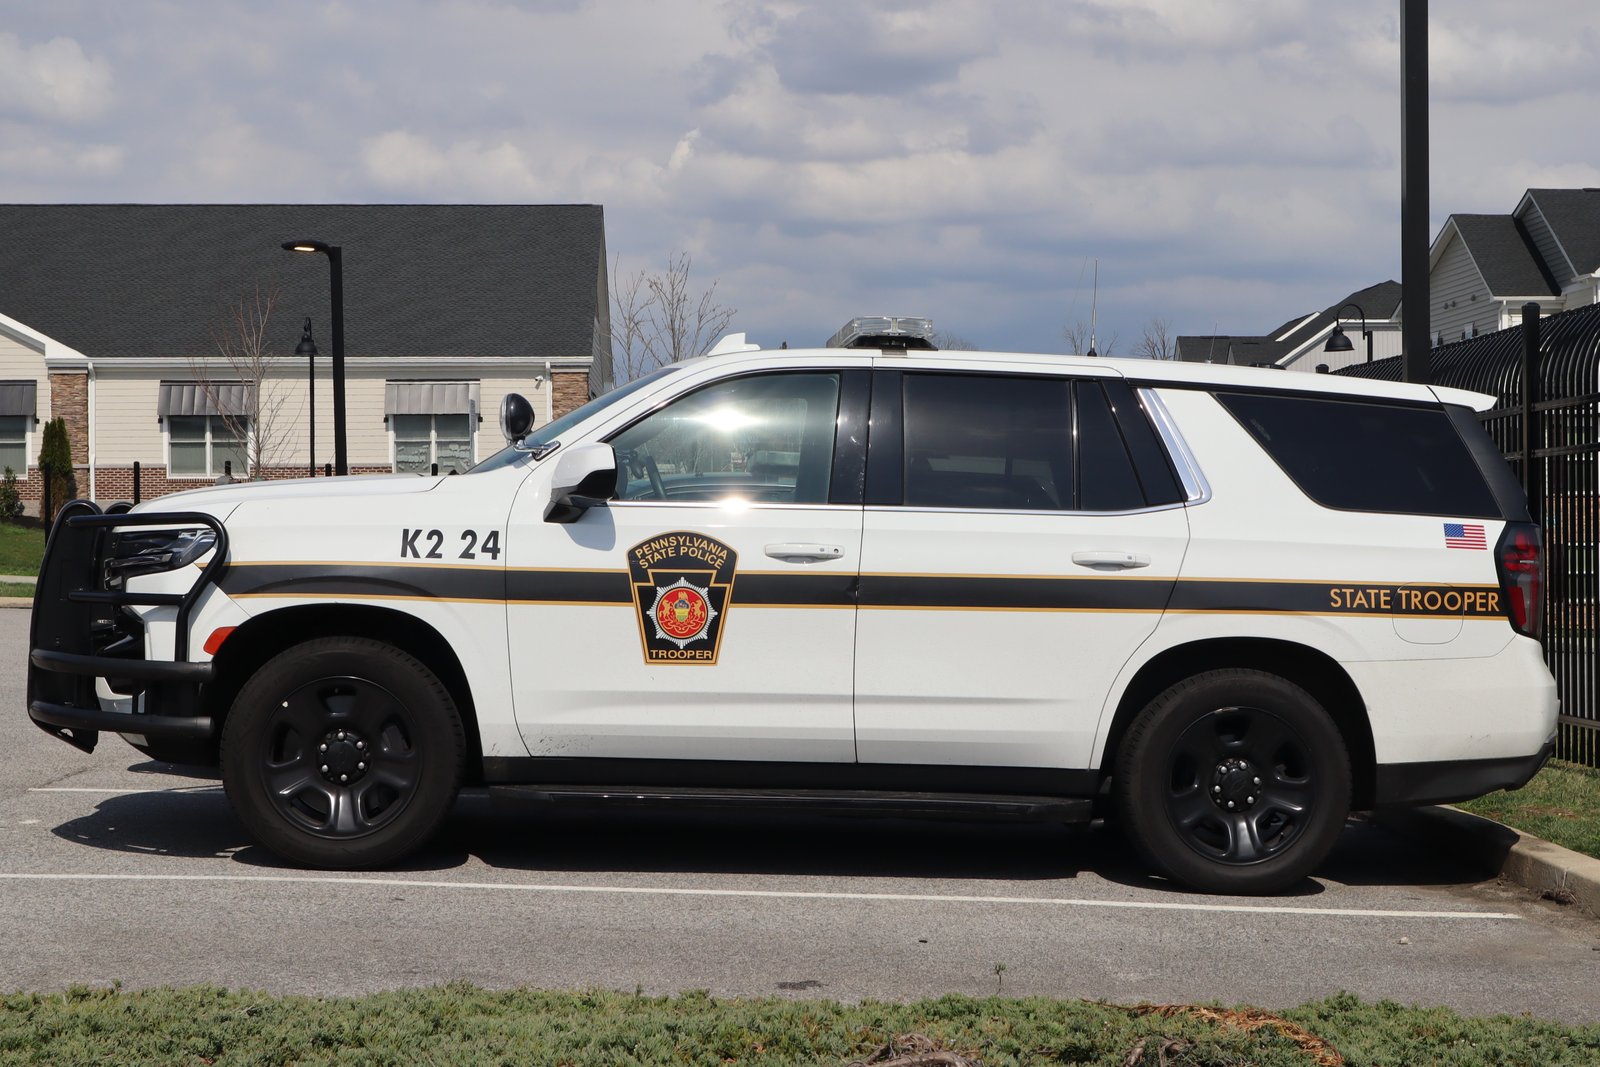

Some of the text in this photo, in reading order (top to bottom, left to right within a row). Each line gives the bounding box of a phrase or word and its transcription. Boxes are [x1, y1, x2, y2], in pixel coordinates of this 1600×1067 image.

[400, 528, 501, 560] K2 24
[635, 536, 728, 560] PENNSYLVANIA
[639, 546, 725, 569] STATE POLICE
[1330, 588, 1500, 612] STATE TROOPER
[650, 649, 712, 659] TROOPER
